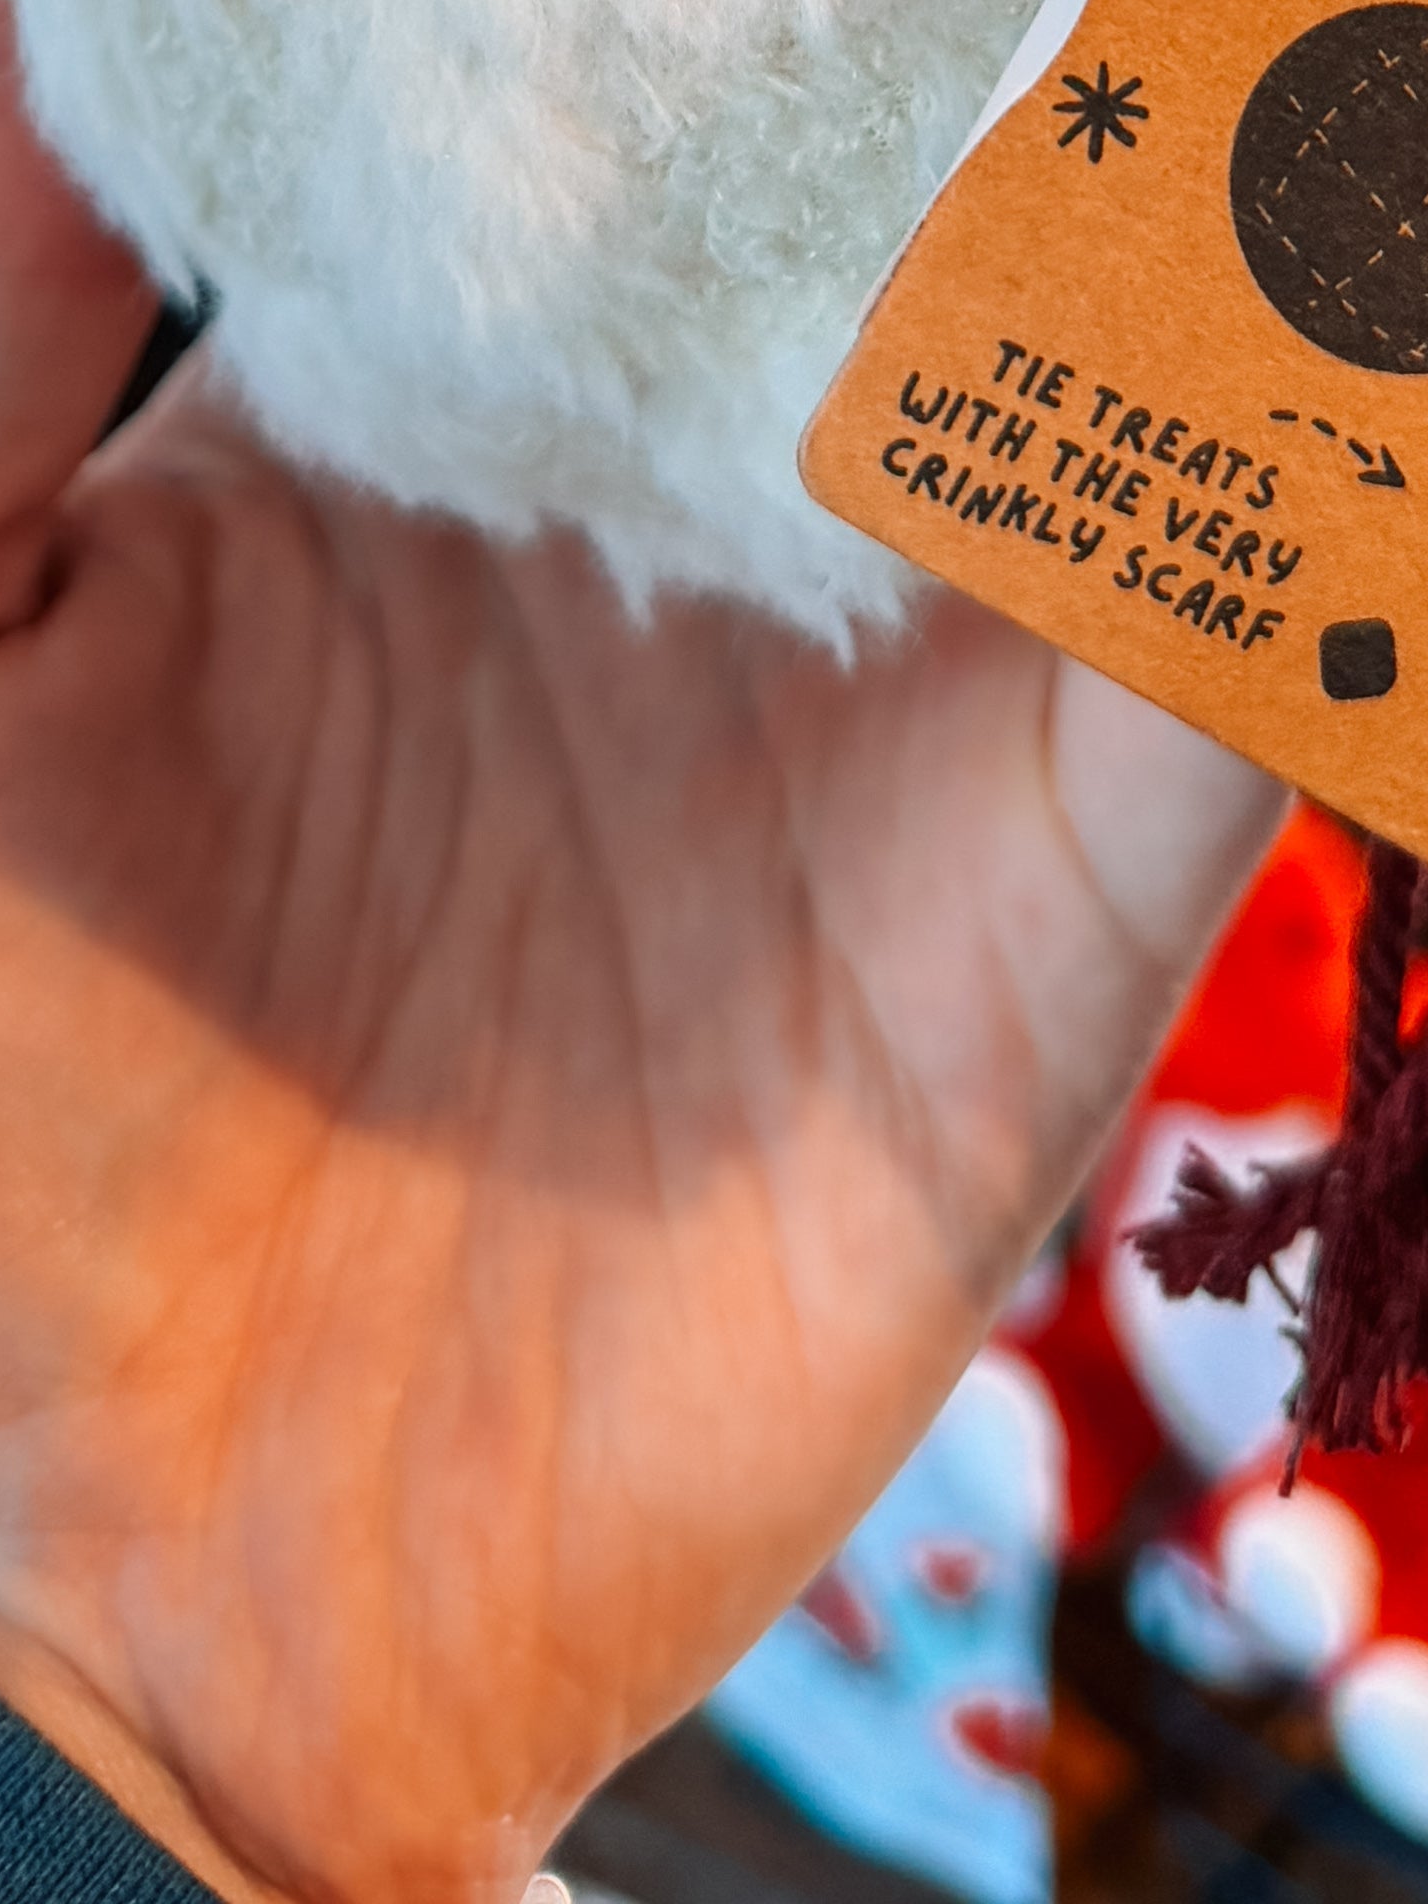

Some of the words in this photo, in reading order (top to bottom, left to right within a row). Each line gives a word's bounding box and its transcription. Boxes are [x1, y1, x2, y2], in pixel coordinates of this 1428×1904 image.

[898, 370, 1038, 464] WITH
[1049, 437, 1153, 519] THE
[1163, 496, 1304, 587] VERY
[992, 339, 1076, 411] TIE
[1088, 384, 1280, 511] TREATS
[880, 437, 1107, 565] CRINKLY
[1112, 544, 1287, 652] SCARF
